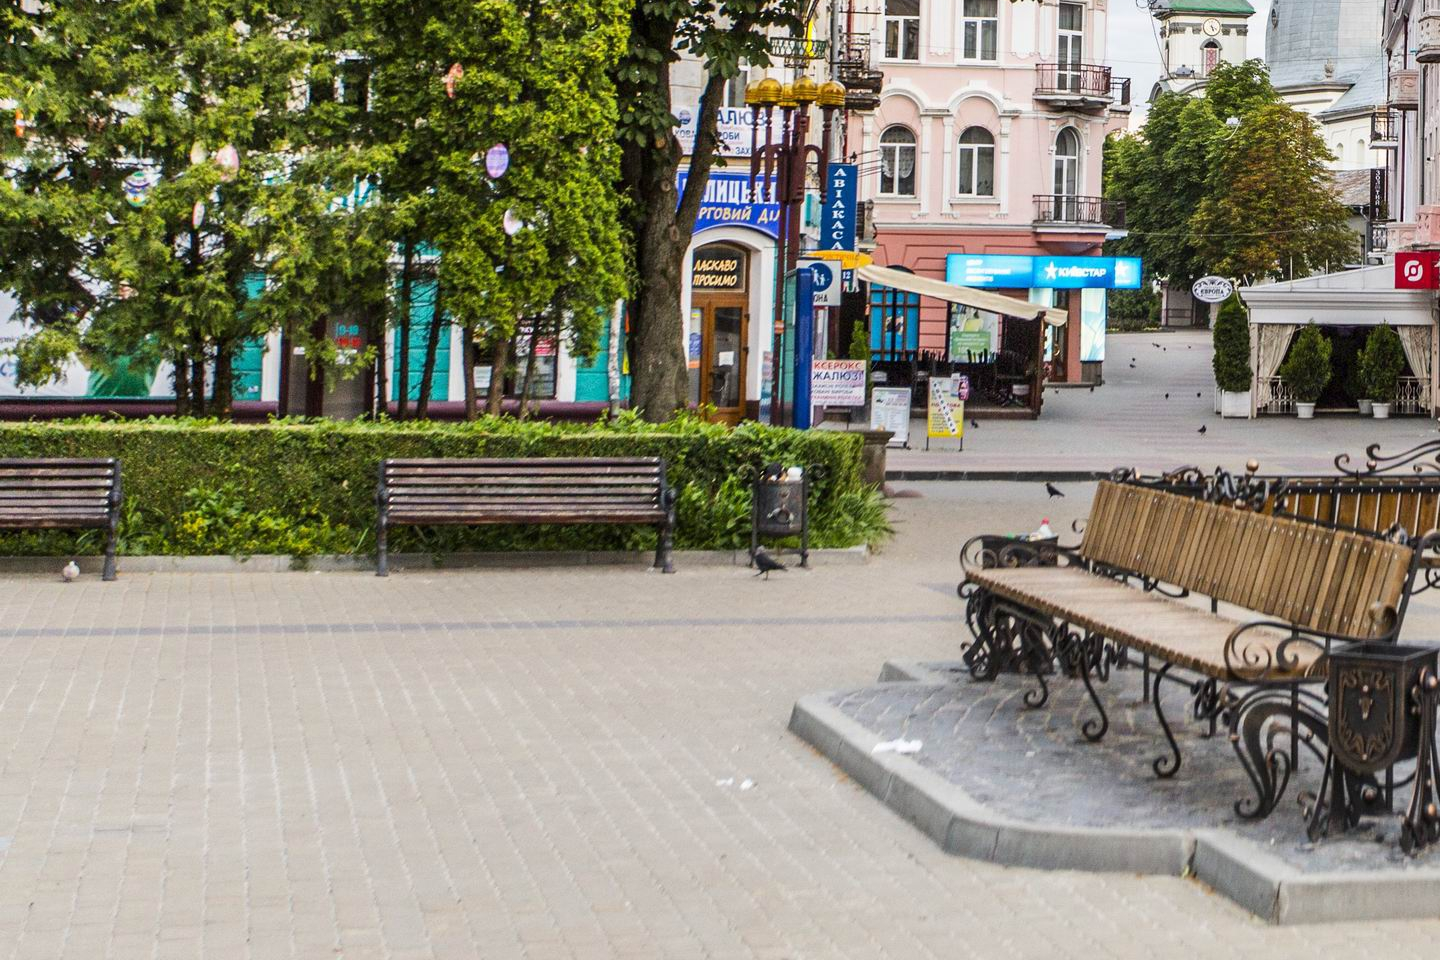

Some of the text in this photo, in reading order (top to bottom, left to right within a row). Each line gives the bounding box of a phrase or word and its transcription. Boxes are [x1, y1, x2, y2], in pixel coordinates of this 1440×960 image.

[693, 259, 737, 272] ЛАСКАВО
[692, 274, 737, 286] ПРОСИМО
[814, 361, 861, 370] КСЕРОКС
